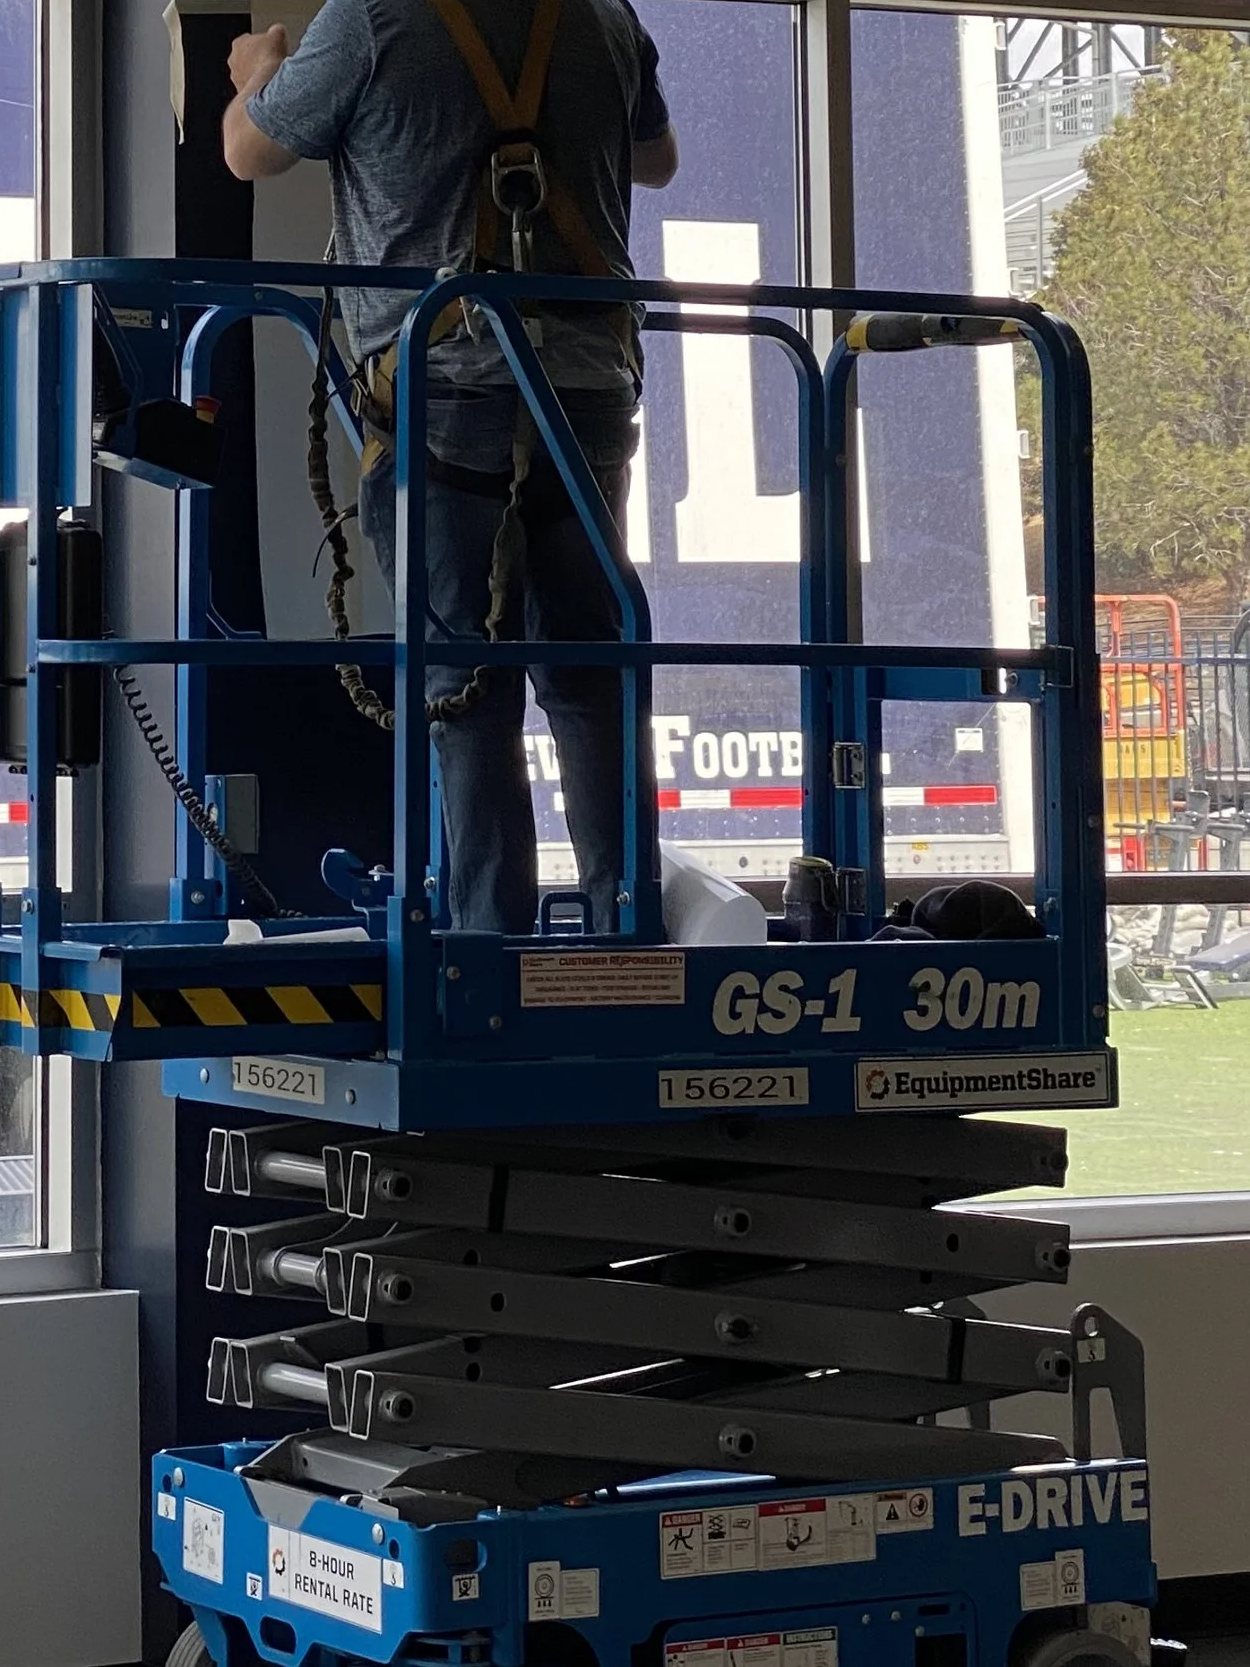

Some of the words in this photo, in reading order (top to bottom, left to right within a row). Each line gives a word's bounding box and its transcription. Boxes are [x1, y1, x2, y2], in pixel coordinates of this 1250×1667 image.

[559, 956, 609, 967] CUSTOMER
[712, 968, 862, 1035] GS-1
[903, 967, 1041, 1031] 30m
[234, 1062, 316, 1096] 156221
[661, 1074, 798, 1100] 156221
[894, 1067, 1097, 1098] EquipmentShare
[958, 1470, 1148, 1537] E-DRIVE
[309, 1550, 355, 1580] 8-HOUR
[294, 1573, 339, 1602] RENTAL
[342, 1588, 373, 1615] RATE
